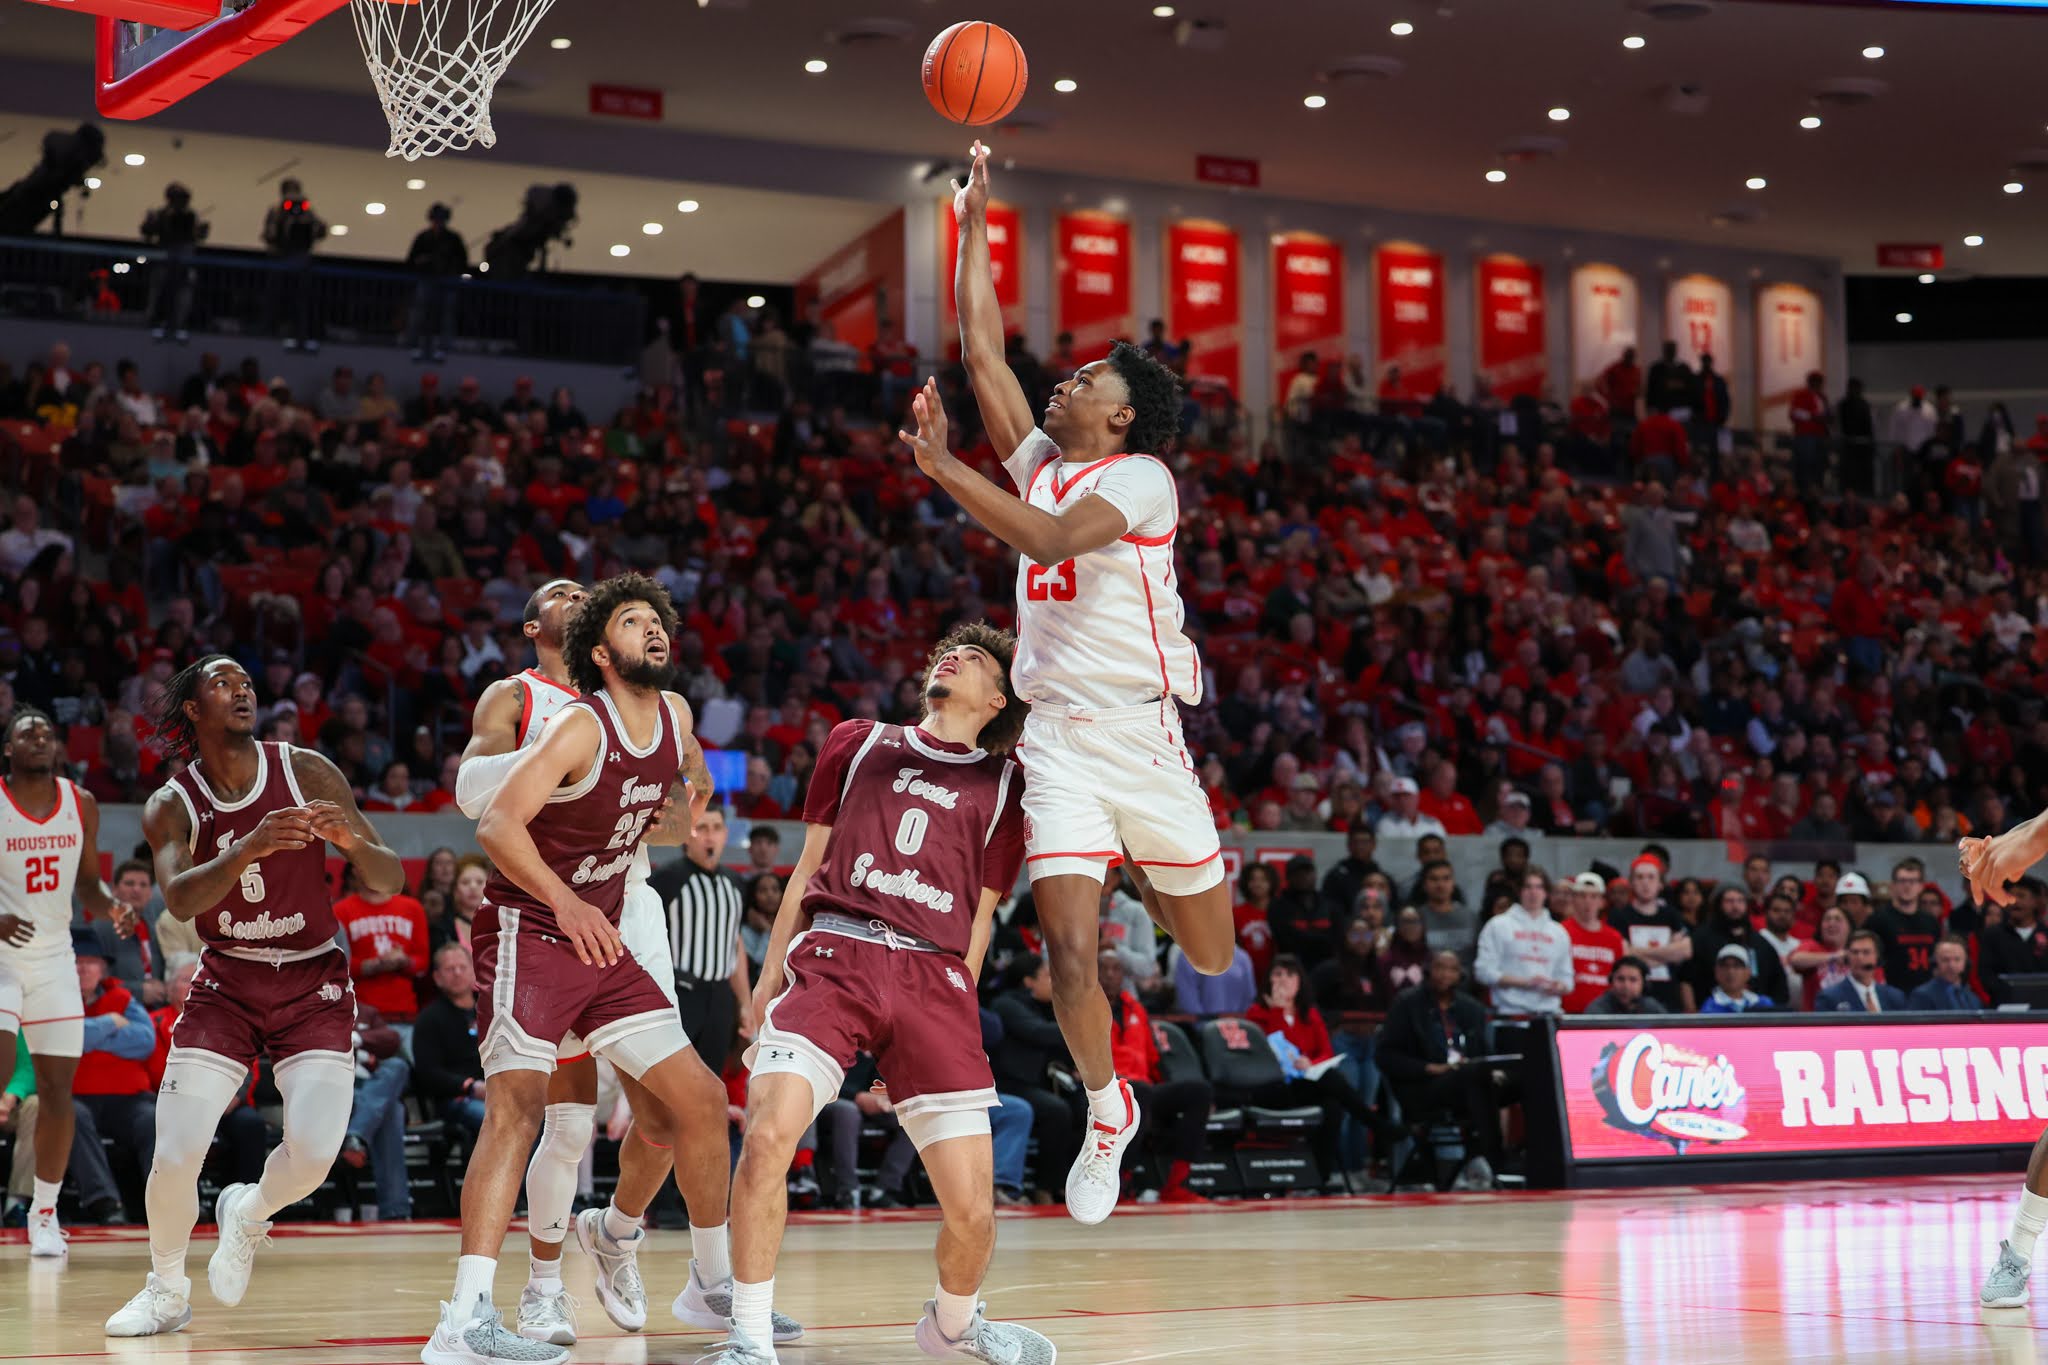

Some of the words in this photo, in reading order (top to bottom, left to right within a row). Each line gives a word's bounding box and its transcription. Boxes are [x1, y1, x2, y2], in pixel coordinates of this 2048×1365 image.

[1027, 557, 1077, 602] 23
[619, 775, 663, 809] Texas
[892, 767, 959, 809] Texas
[6, 834, 77, 852] HOUSTON
[603, 807, 654, 850] 25
[895, 807, 929, 856] 0
[25, 856, 60, 894] 25
[240, 862, 266, 904] 5
[850, 852, 955, 913] Southern
[218, 910, 306, 941] Southern
[1616, 1032, 1745, 1125] Cane's
